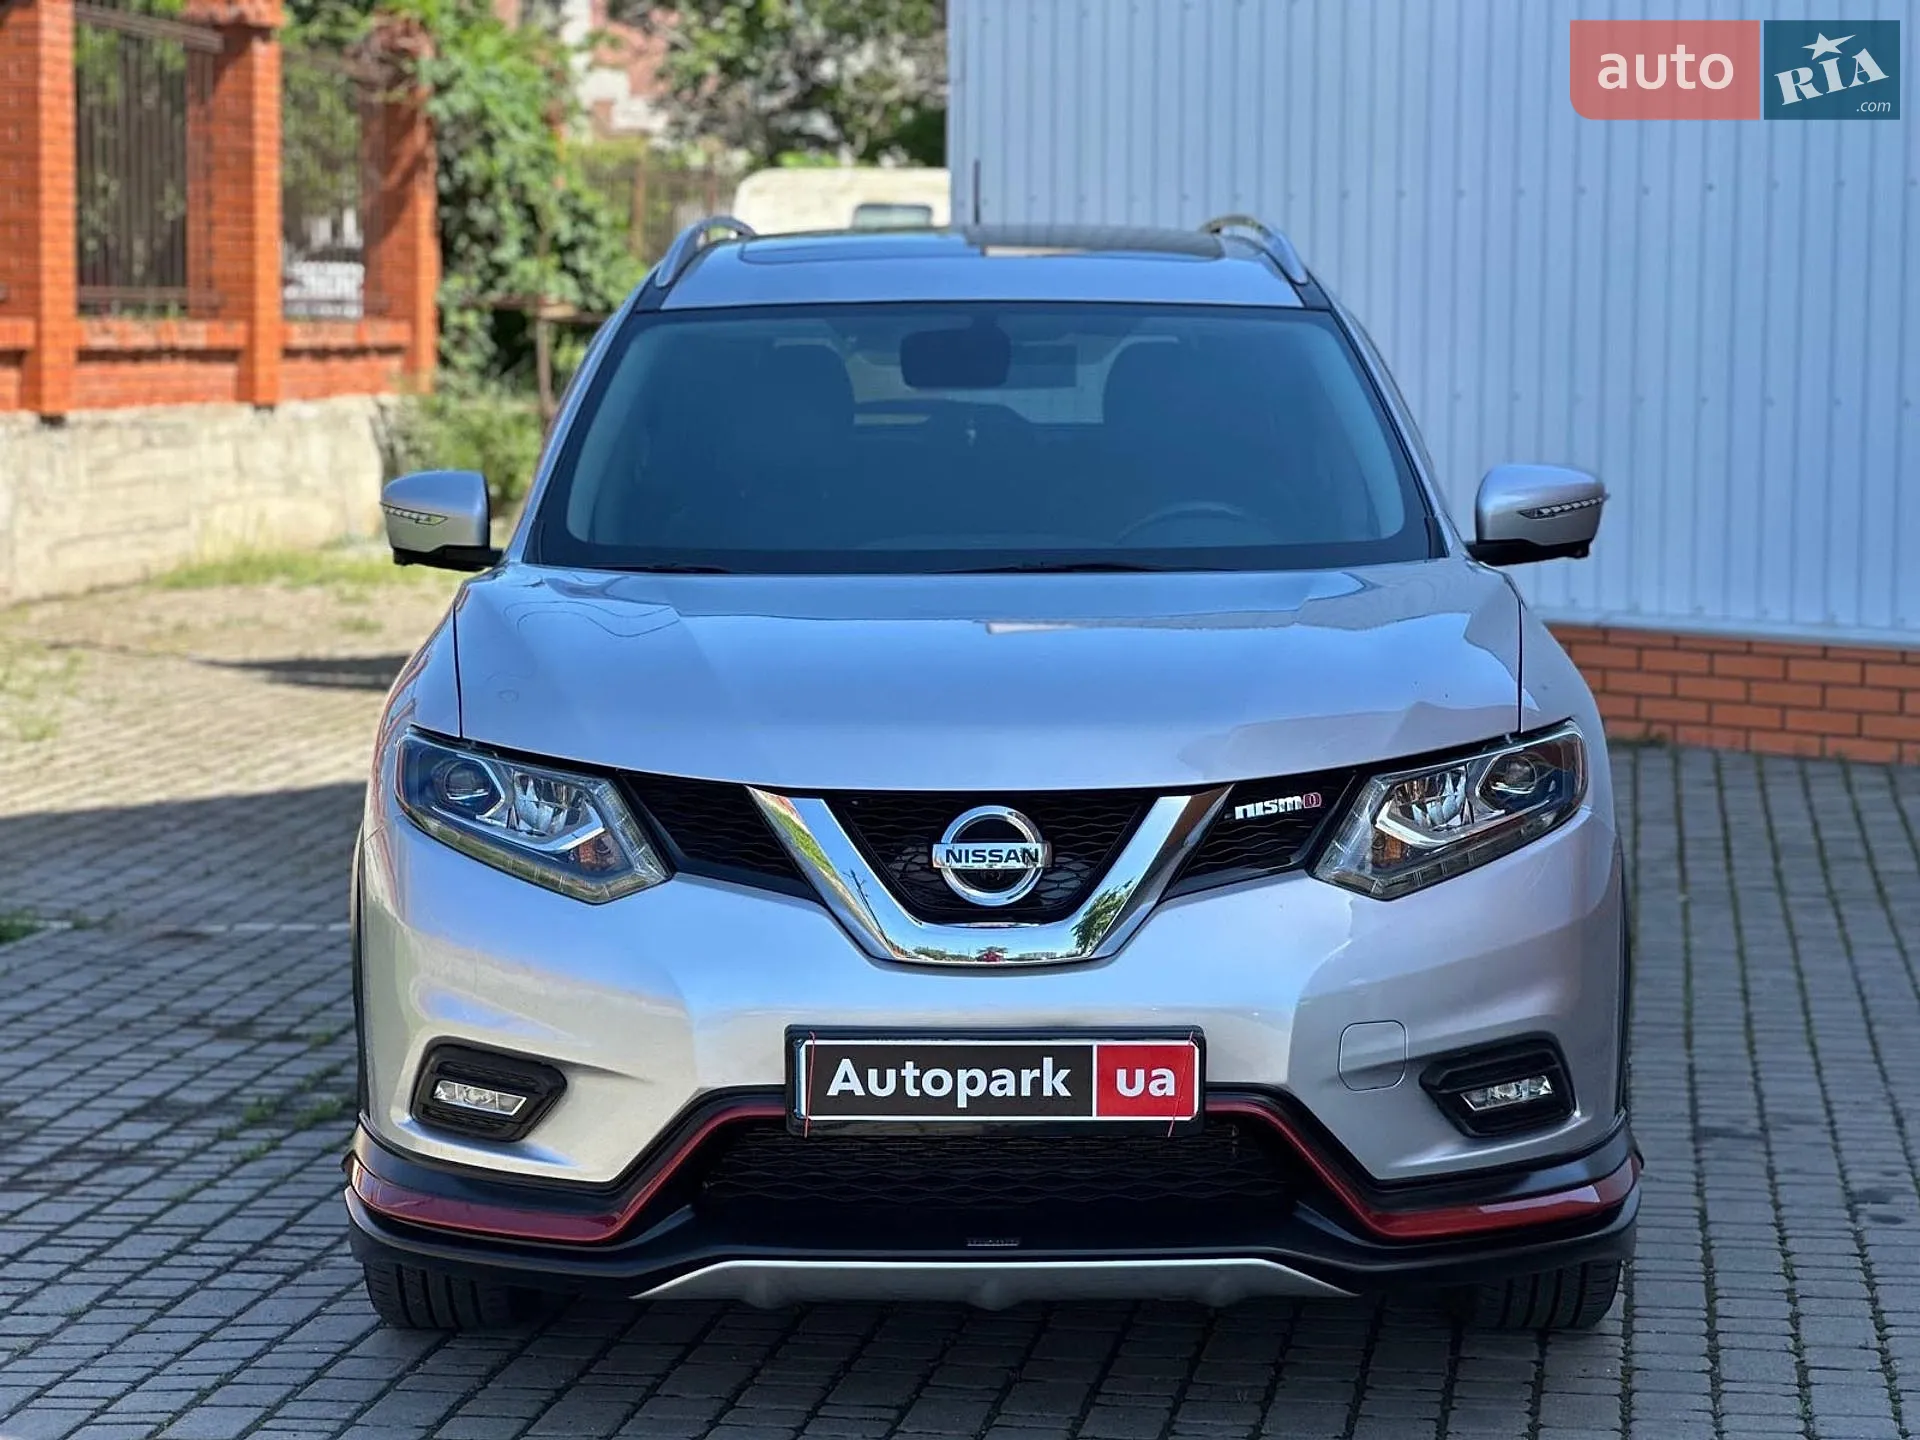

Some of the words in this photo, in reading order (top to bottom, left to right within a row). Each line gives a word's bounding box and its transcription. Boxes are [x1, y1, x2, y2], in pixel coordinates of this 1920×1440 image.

[945, 847, 1039, 864] NISSAN
[826, 1057, 1072, 1108] Autopark
[1116, 1067, 1176, 1097] ua
